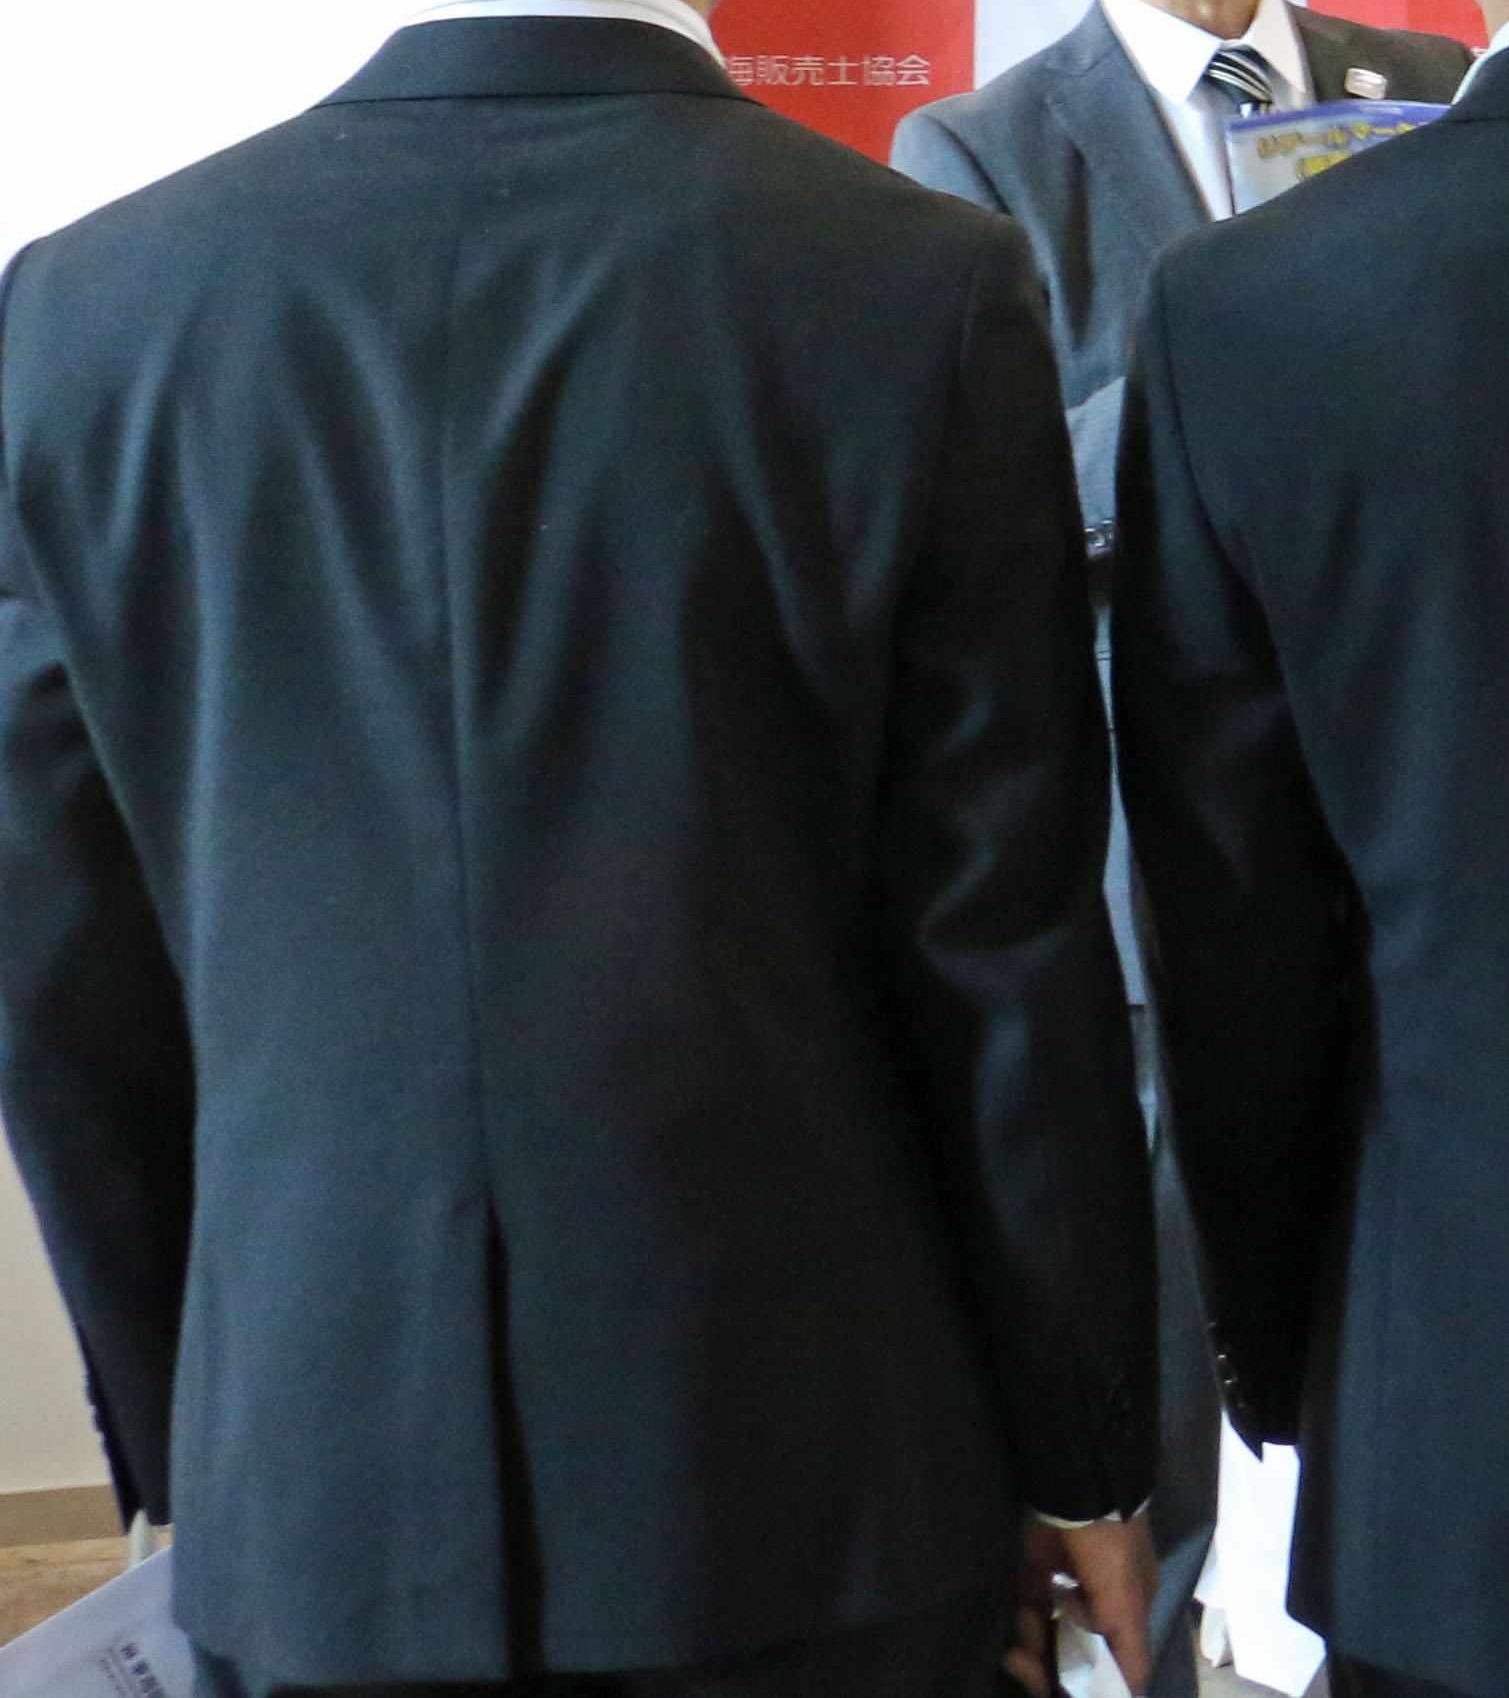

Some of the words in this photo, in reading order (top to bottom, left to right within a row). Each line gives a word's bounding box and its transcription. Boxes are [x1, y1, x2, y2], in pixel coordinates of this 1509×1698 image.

[727, 53, 932, 87] 海販売士協会
